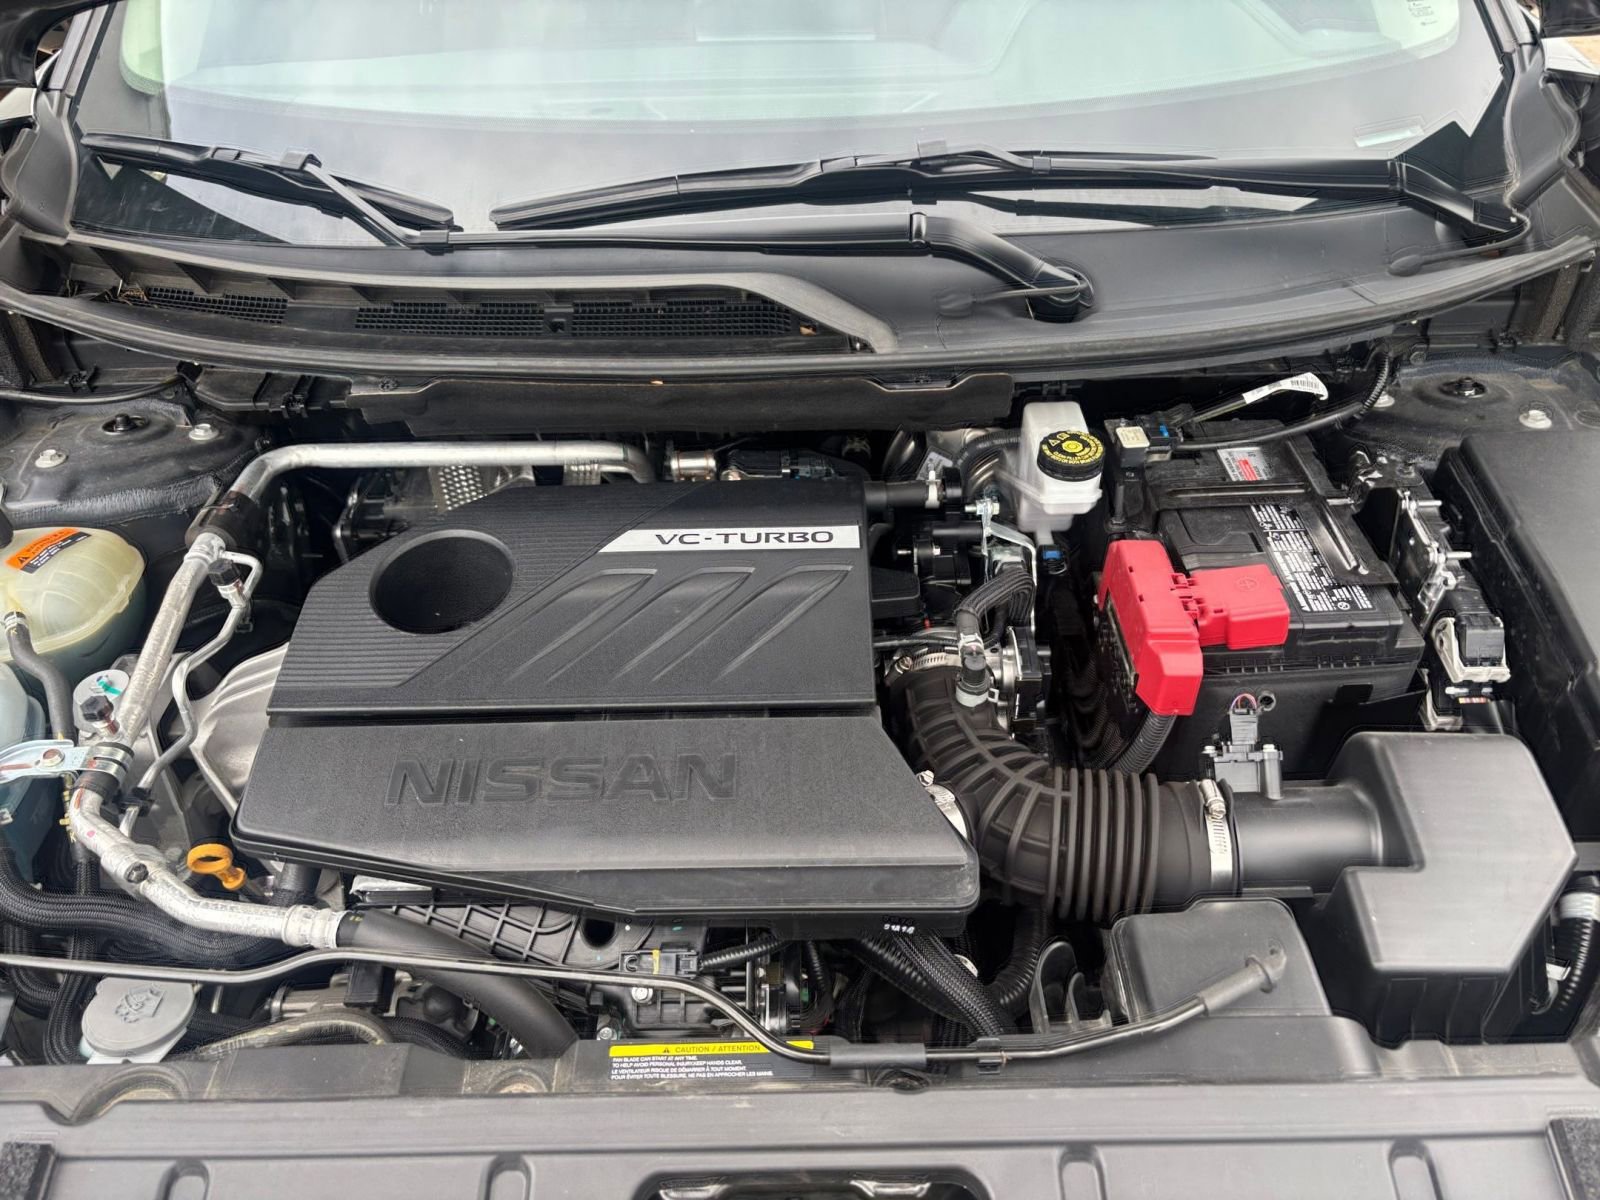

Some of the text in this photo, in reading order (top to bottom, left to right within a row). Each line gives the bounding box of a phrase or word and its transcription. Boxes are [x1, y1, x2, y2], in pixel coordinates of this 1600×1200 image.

[655, 530, 834, 546] VC-TURBO
[384, 753, 736, 806] NISSAN
[675, 1046, 710, 1054] CAUTION
[718, 1044, 761, 1052] ATTENTION
[678, 1065, 705, 1073] DÉMARRER
[626, 1072, 643, 1080] ÉVITER
